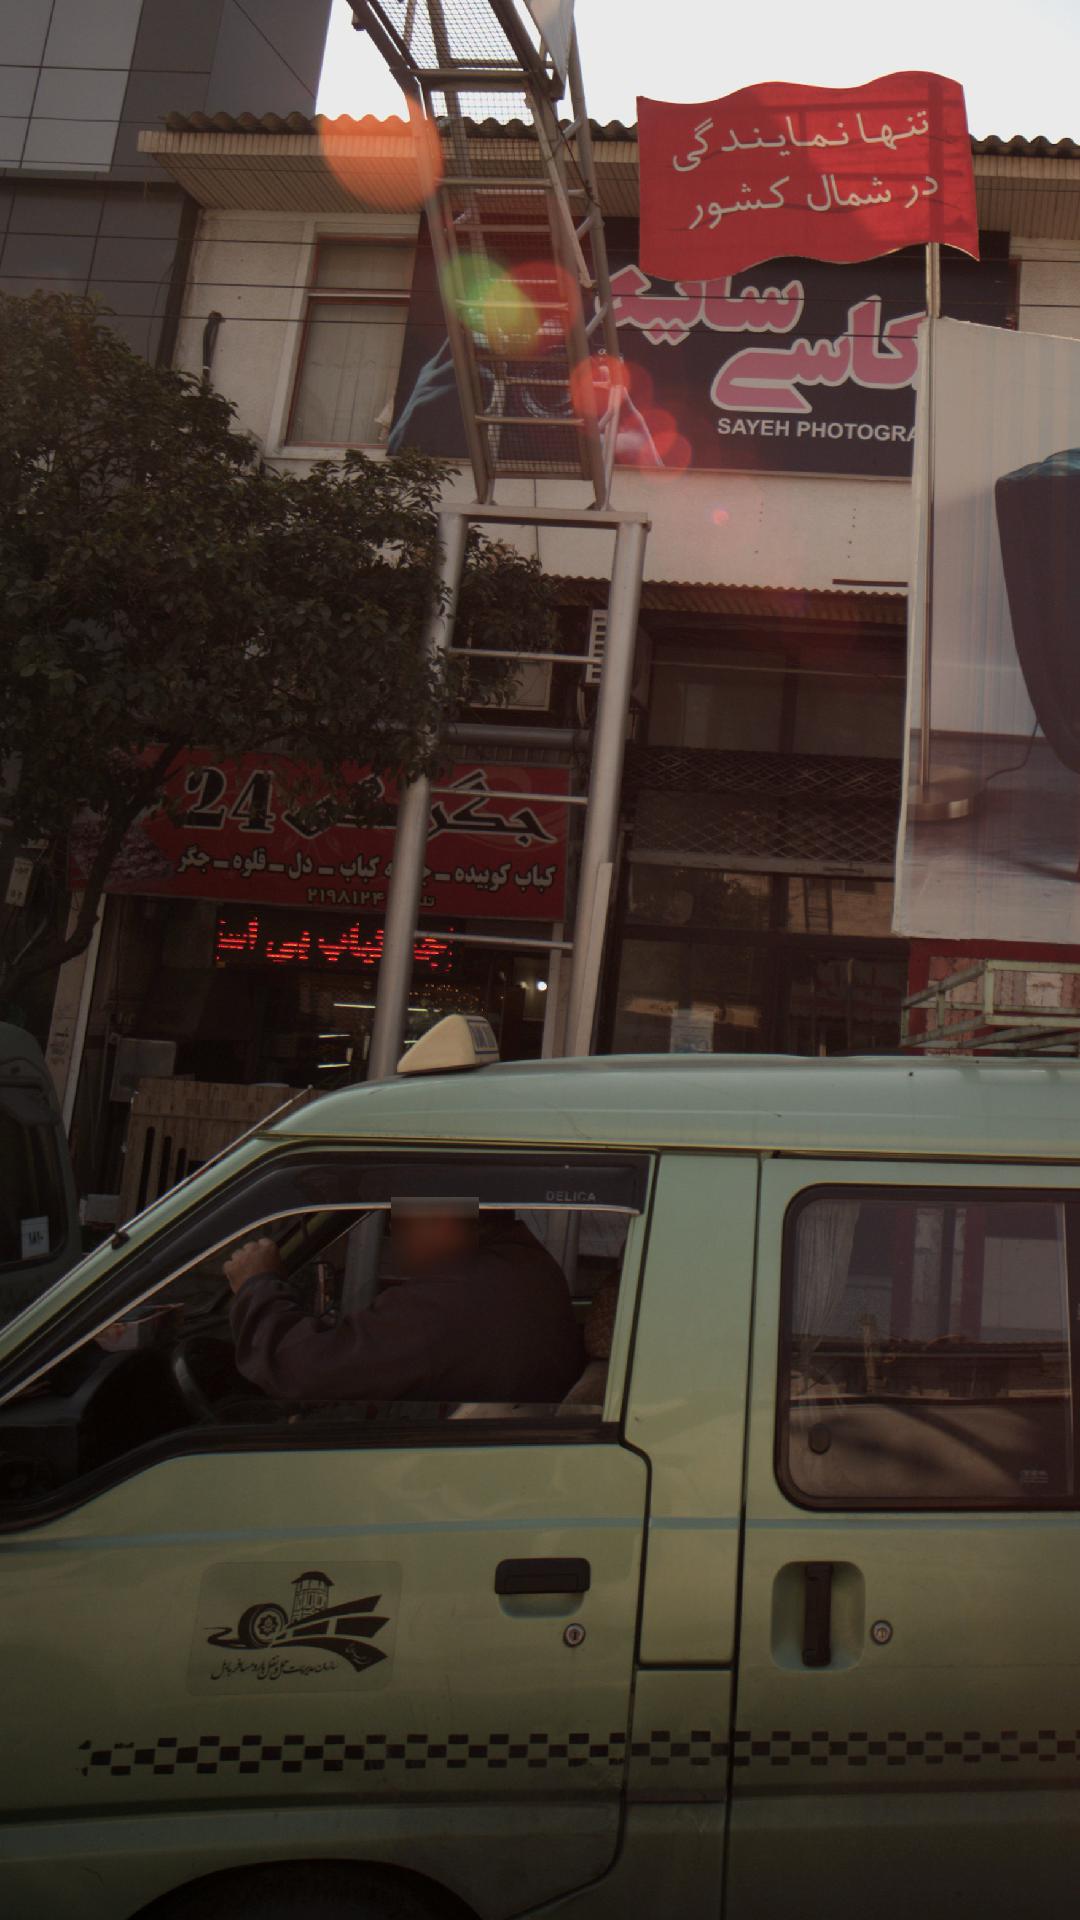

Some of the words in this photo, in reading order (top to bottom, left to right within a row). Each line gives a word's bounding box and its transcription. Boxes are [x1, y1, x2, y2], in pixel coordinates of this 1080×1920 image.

[856, 110, 929, 151] تنها
[688, 176, 791, 230] کشور
[807, 174, 892, 212] شمال
[904, 176, 938, 208] در
[717, 417, 790, 437] SAYEH
[182, 766, 278, 833] 24
[232, 847, 267, 877] قلوه
[288, 851, 312, 880] دل
[339, 854, 381, 883] کباب
[455, 863, 512, 892] کوبیده
[515, 863, 557, 893] کباب
[545, 1190, 597, 1202] DELICA
